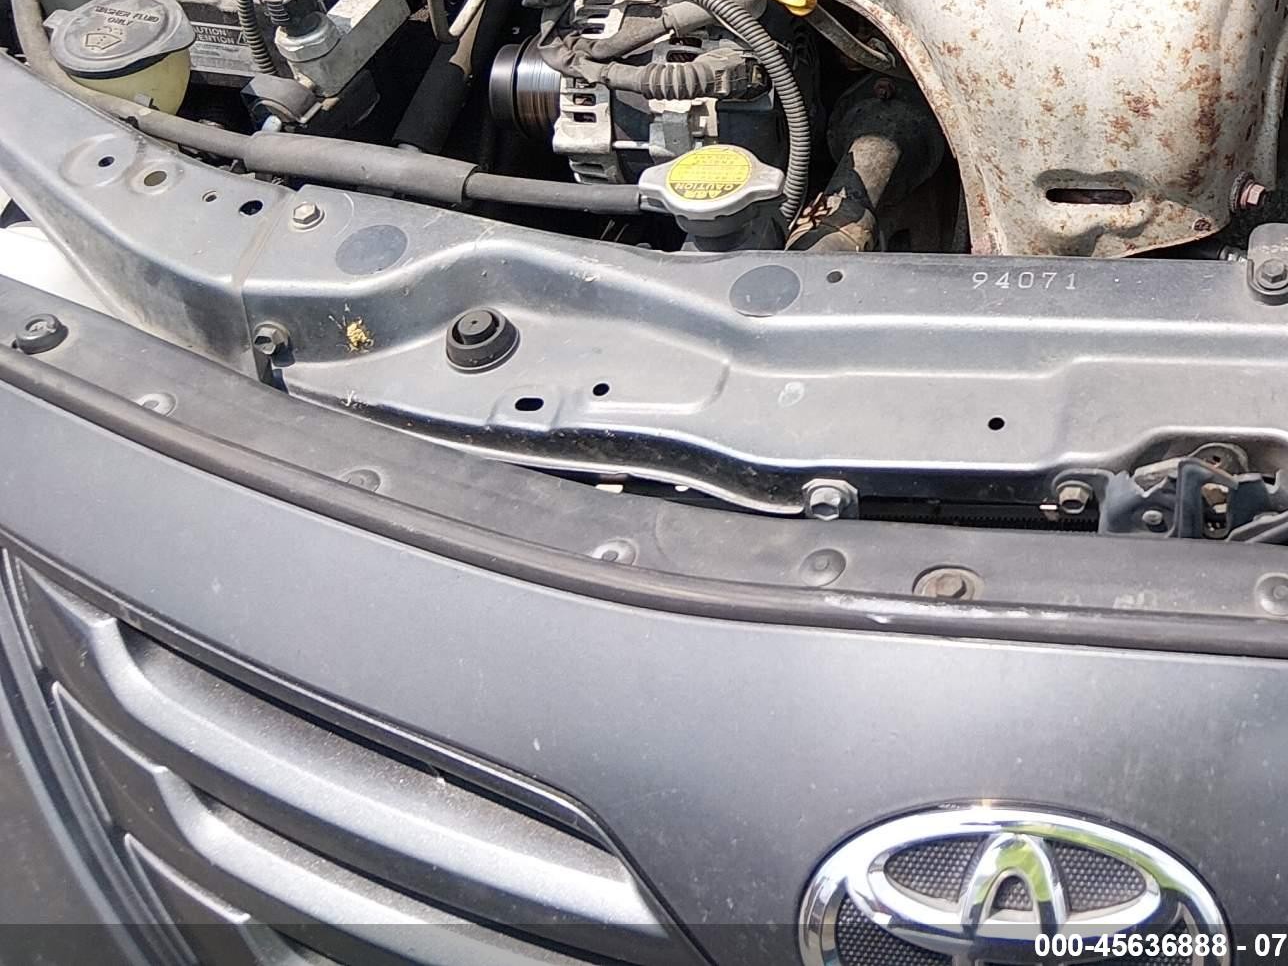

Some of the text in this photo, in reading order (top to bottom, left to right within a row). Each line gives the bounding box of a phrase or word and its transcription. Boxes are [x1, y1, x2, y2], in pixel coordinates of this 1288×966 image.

[107, 17, 134, 26] ONLY
[132, 12, 160, 23] FLUID
[674, 182, 735, 192] CAUTION
[971, 271, 1077, 290] 94071
